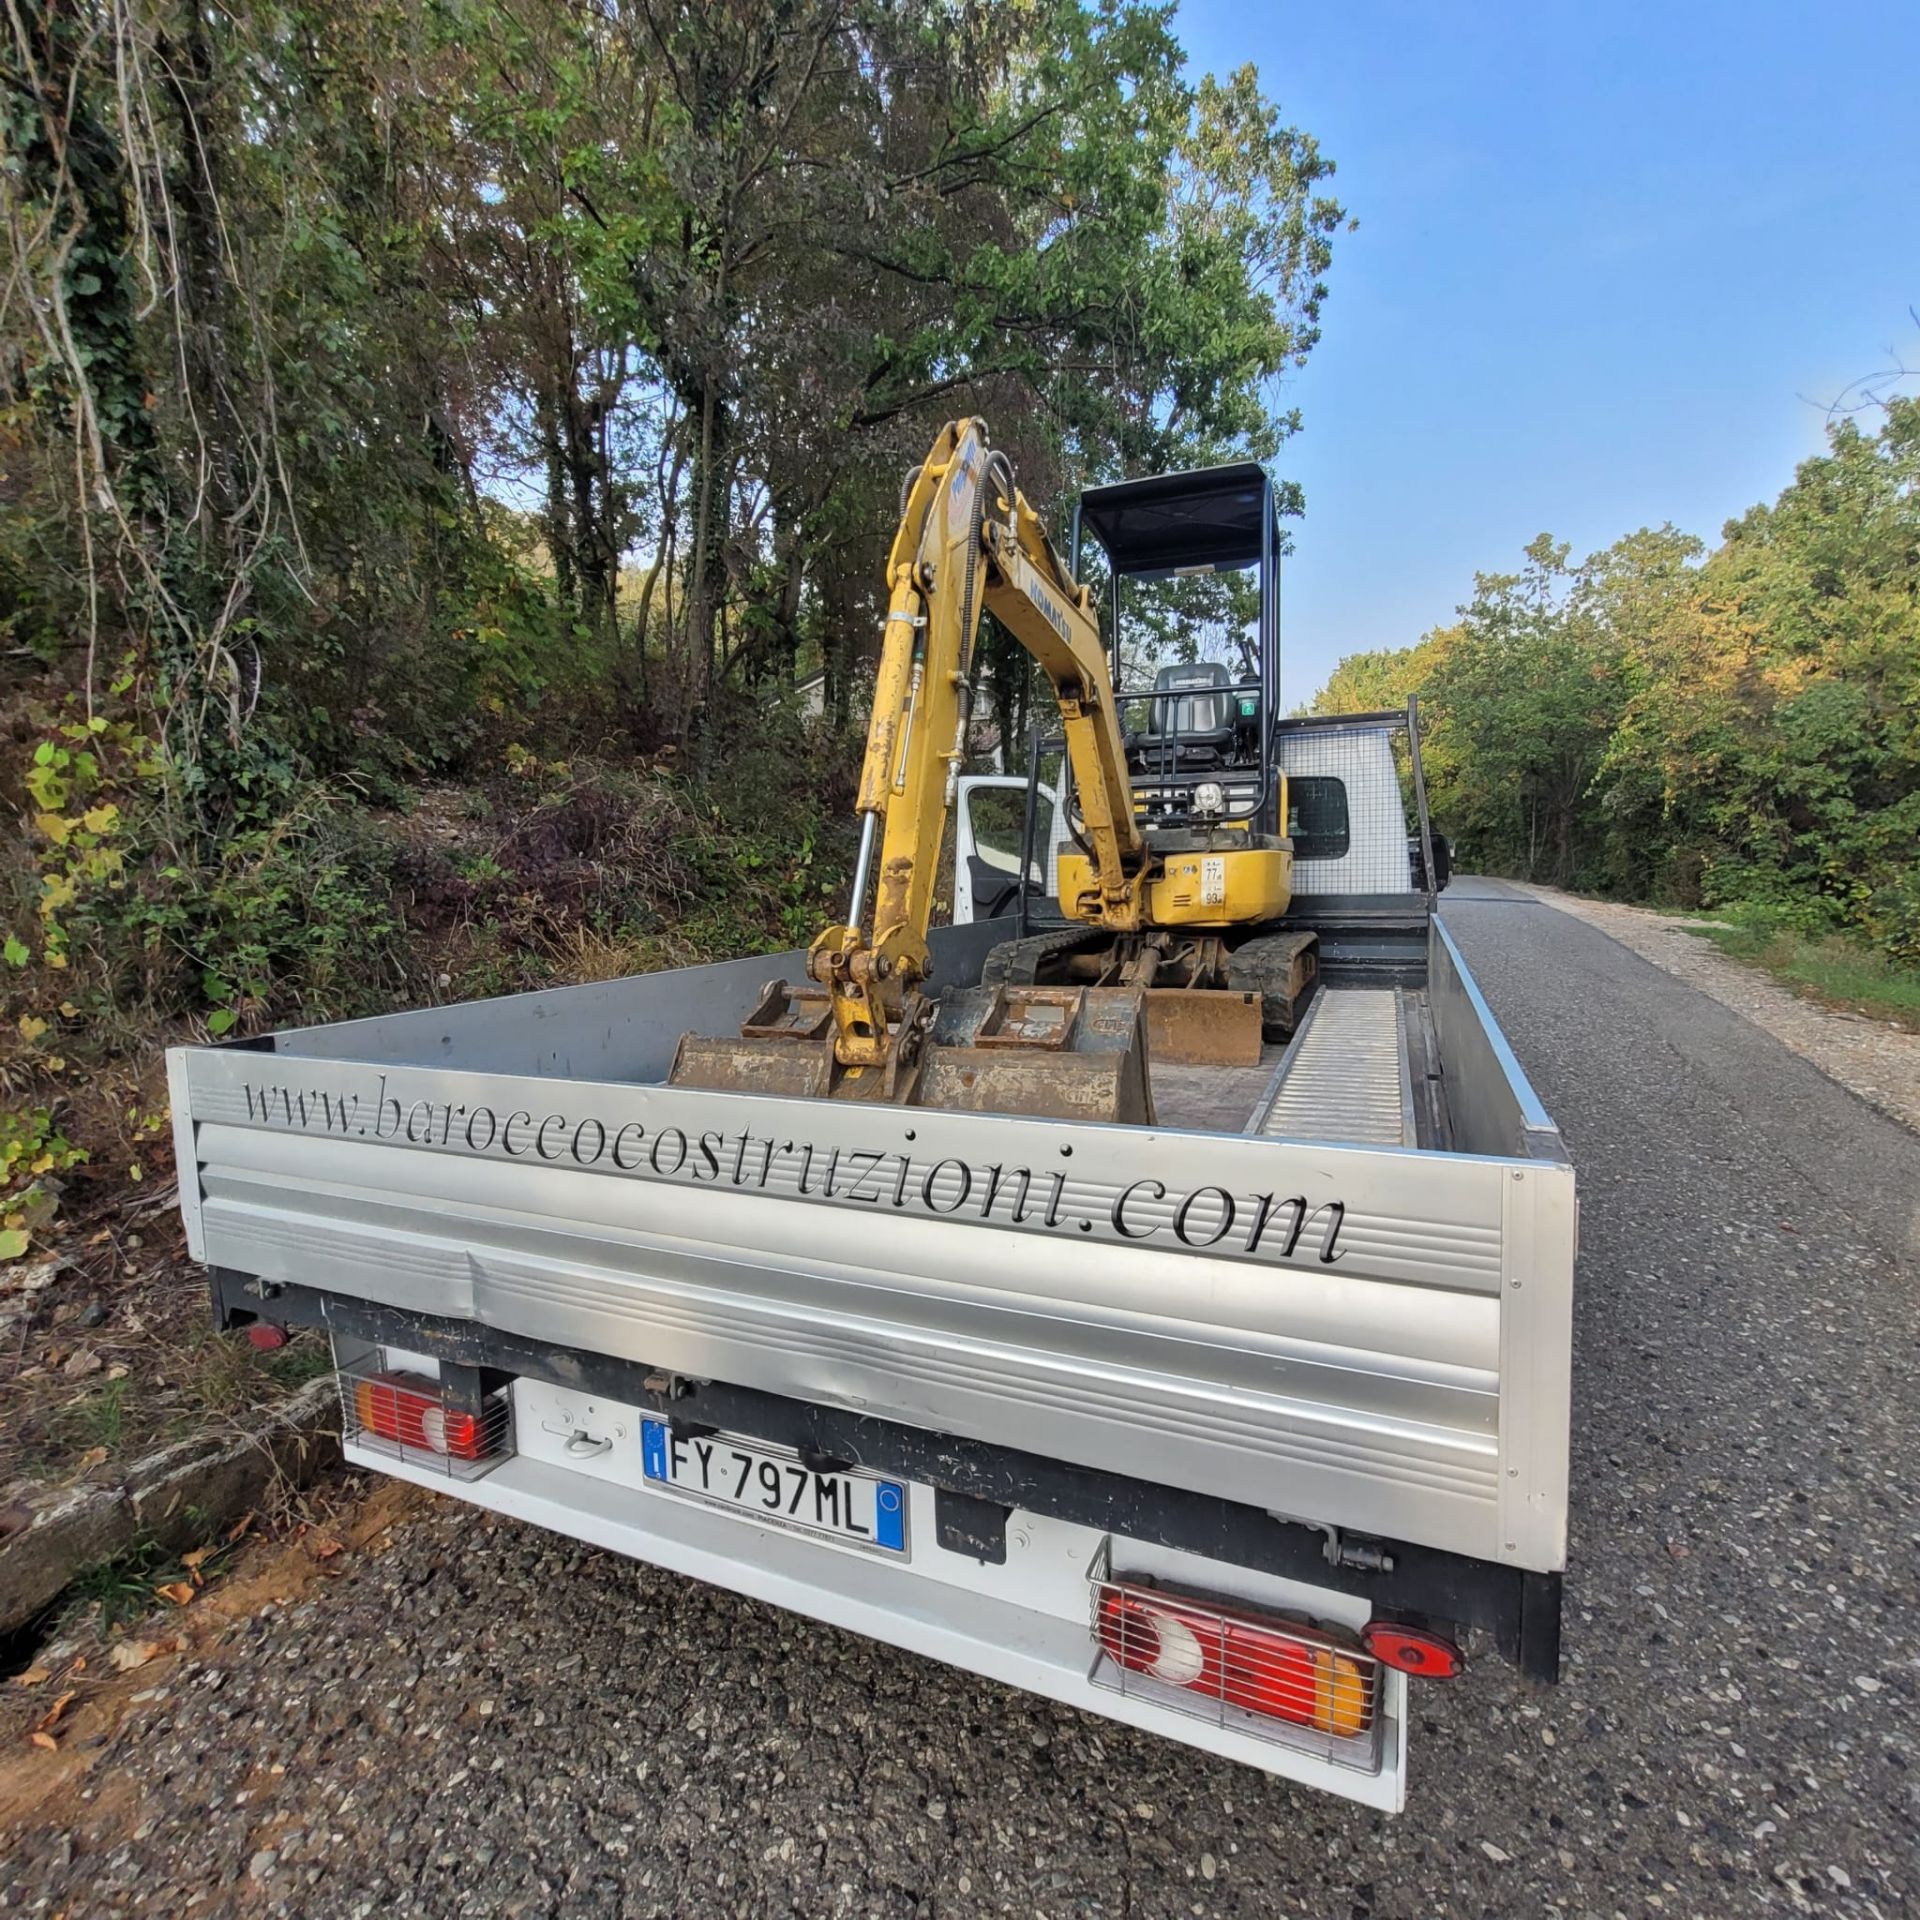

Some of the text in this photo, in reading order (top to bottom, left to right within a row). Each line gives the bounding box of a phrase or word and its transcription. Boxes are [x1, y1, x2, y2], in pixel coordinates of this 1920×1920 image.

[1030, 576, 1072, 645] KOMATSU
[1206, 868, 1217, 880] 77
[241, 1073, 1348, 1264] www.baroccocostruzioni.com
